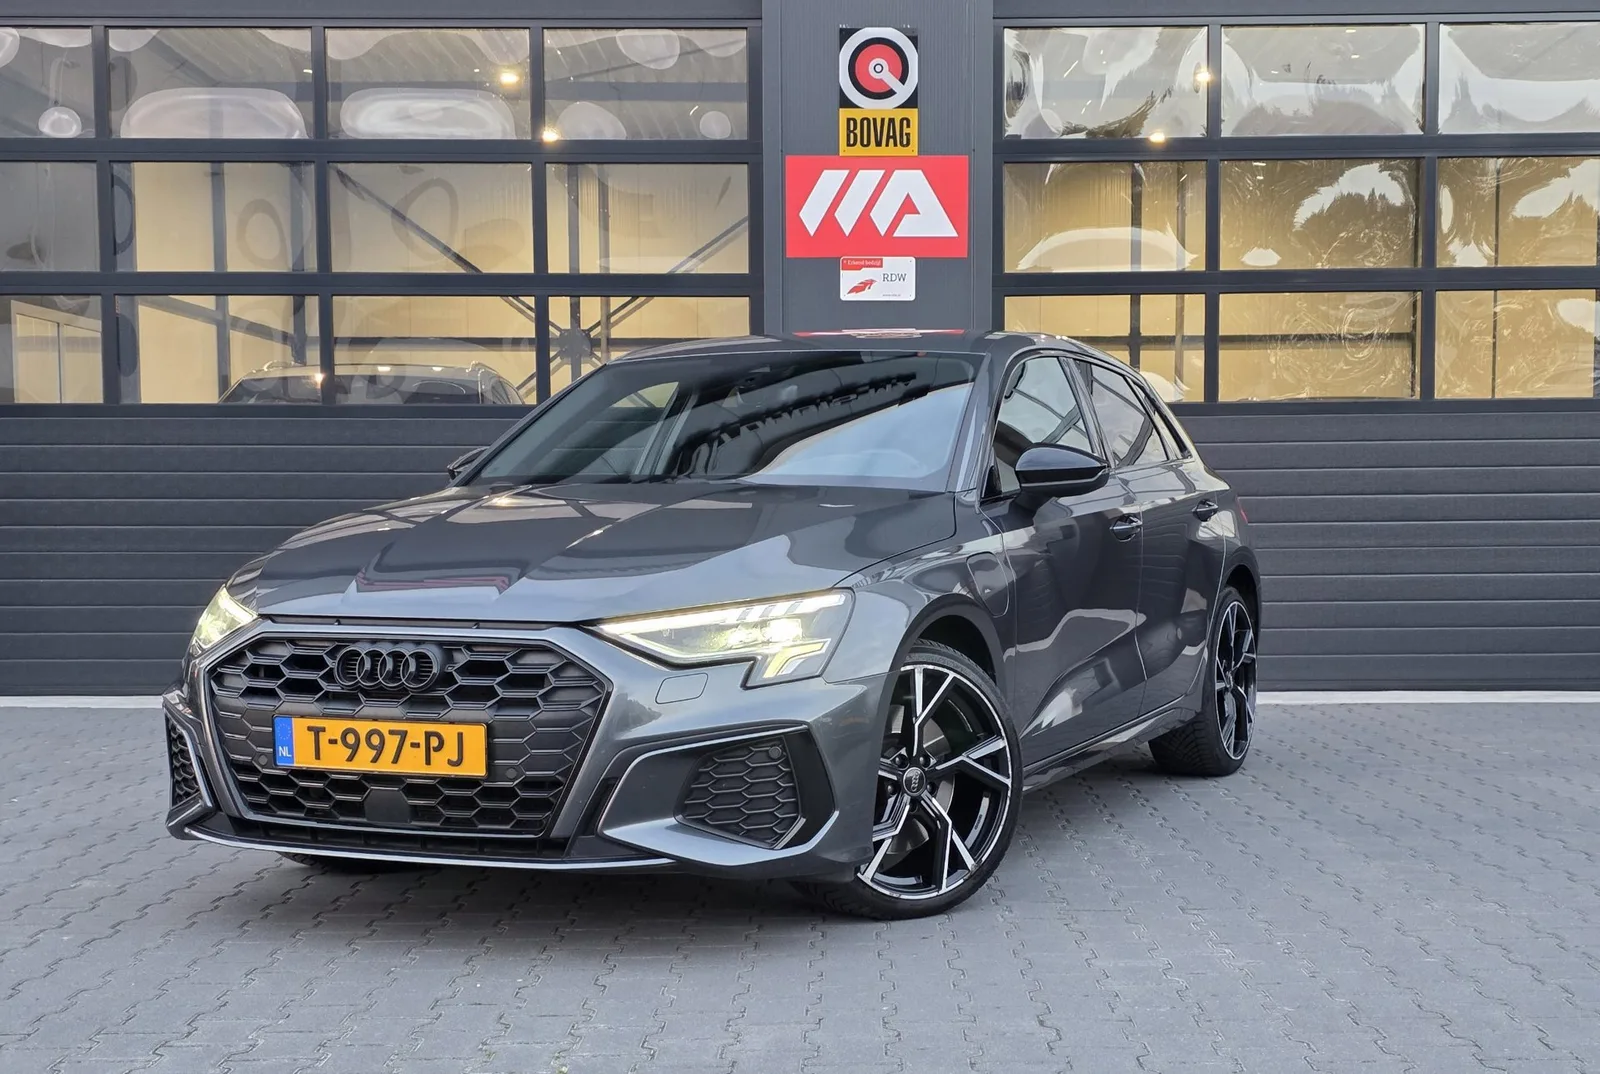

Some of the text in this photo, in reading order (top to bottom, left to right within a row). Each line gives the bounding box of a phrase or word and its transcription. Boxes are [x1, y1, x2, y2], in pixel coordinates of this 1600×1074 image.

[846, 117, 911, 148] BOVAG
[882, 273, 907, 282] RDW
[278, 746, 292, 758] NL
[306, 725, 464, 767] T-997-PJ
